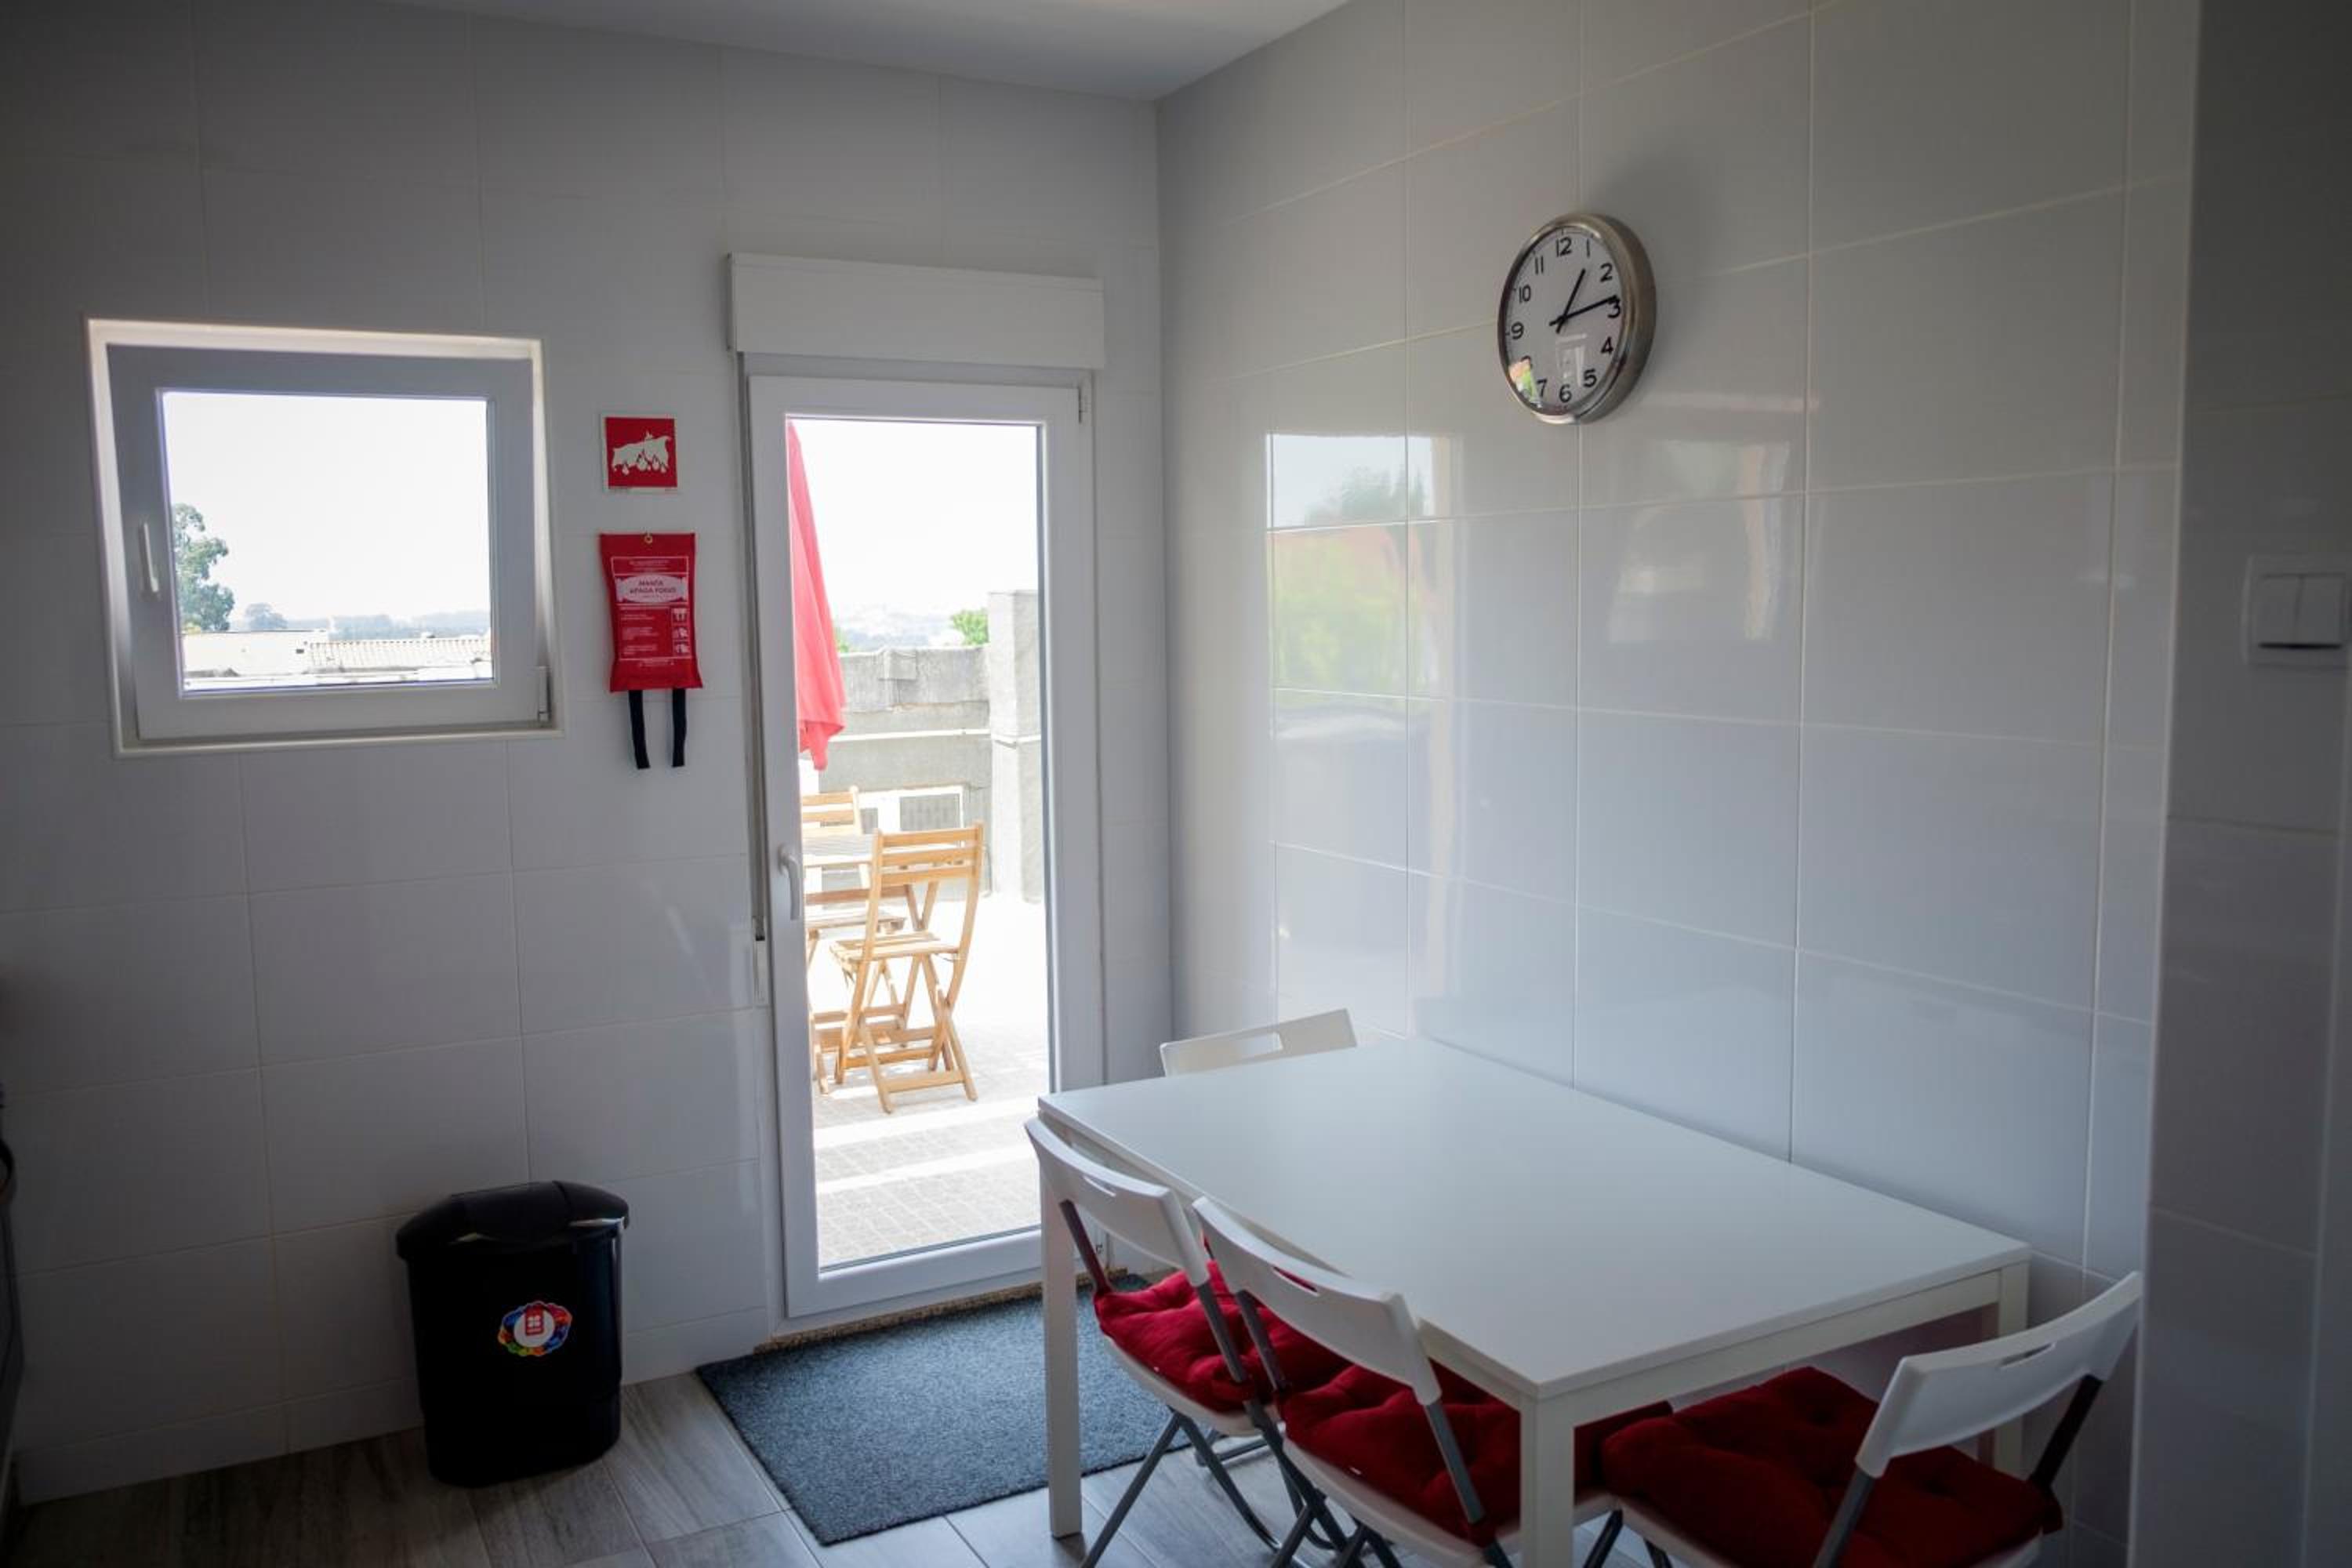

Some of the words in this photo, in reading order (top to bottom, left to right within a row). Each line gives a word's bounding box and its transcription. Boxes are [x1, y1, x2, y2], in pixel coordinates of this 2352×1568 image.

[1555, 238, 1573, 257] 12
[1586, 238, 1592, 258] 1
[1534, 256, 1544, 274] 11
[1600, 263, 1613, 281] 2
[1519, 285, 1531, 303] 10
[1607, 299, 1621, 318] 3
[1511, 322, 1524, 339] 9
[1600, 336, 1613, 354] 4
[1583, 369, 1597, 387] 5
[1537, 379, 1548, 397] 7
[1559, 384, 1572, 403] 6
